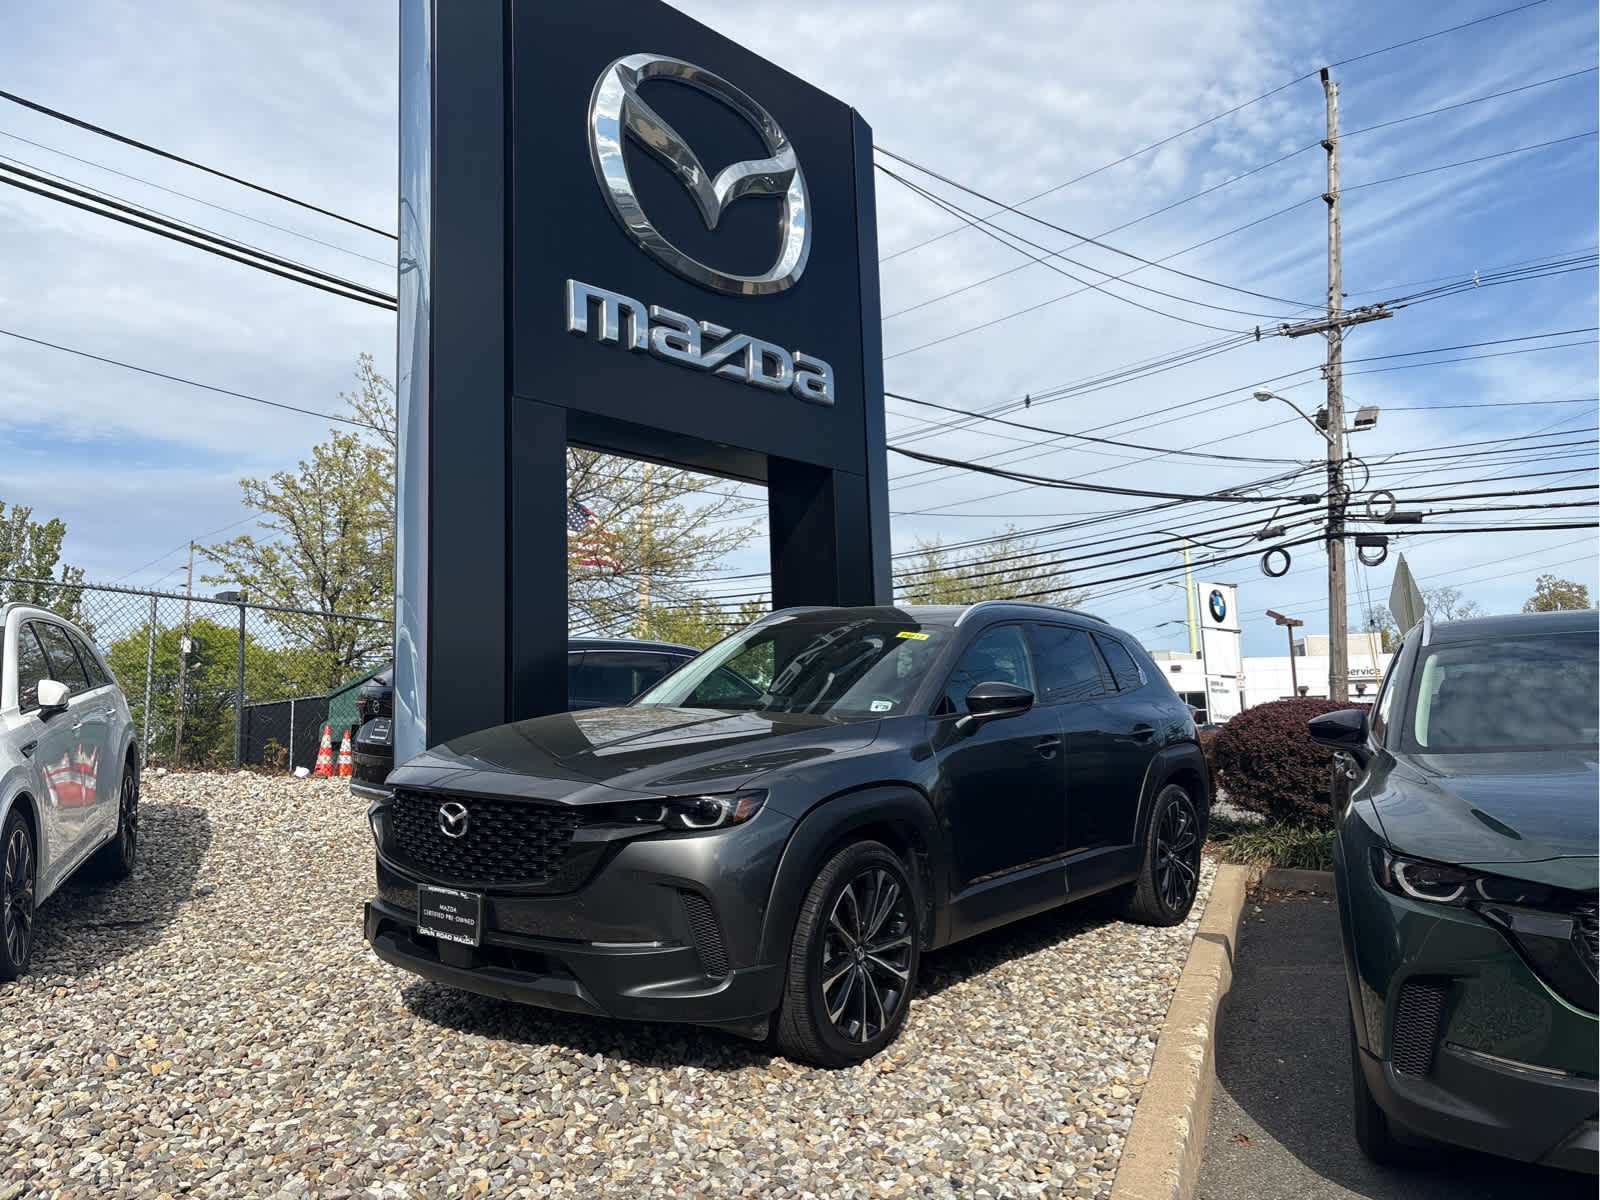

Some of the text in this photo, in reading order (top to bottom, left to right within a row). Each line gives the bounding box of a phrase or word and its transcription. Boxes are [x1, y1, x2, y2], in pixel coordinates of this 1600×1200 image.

[439, 904, 457, 913] MAZDA
[419, 928, 474, 945] OPEN ROAD MAZDA
